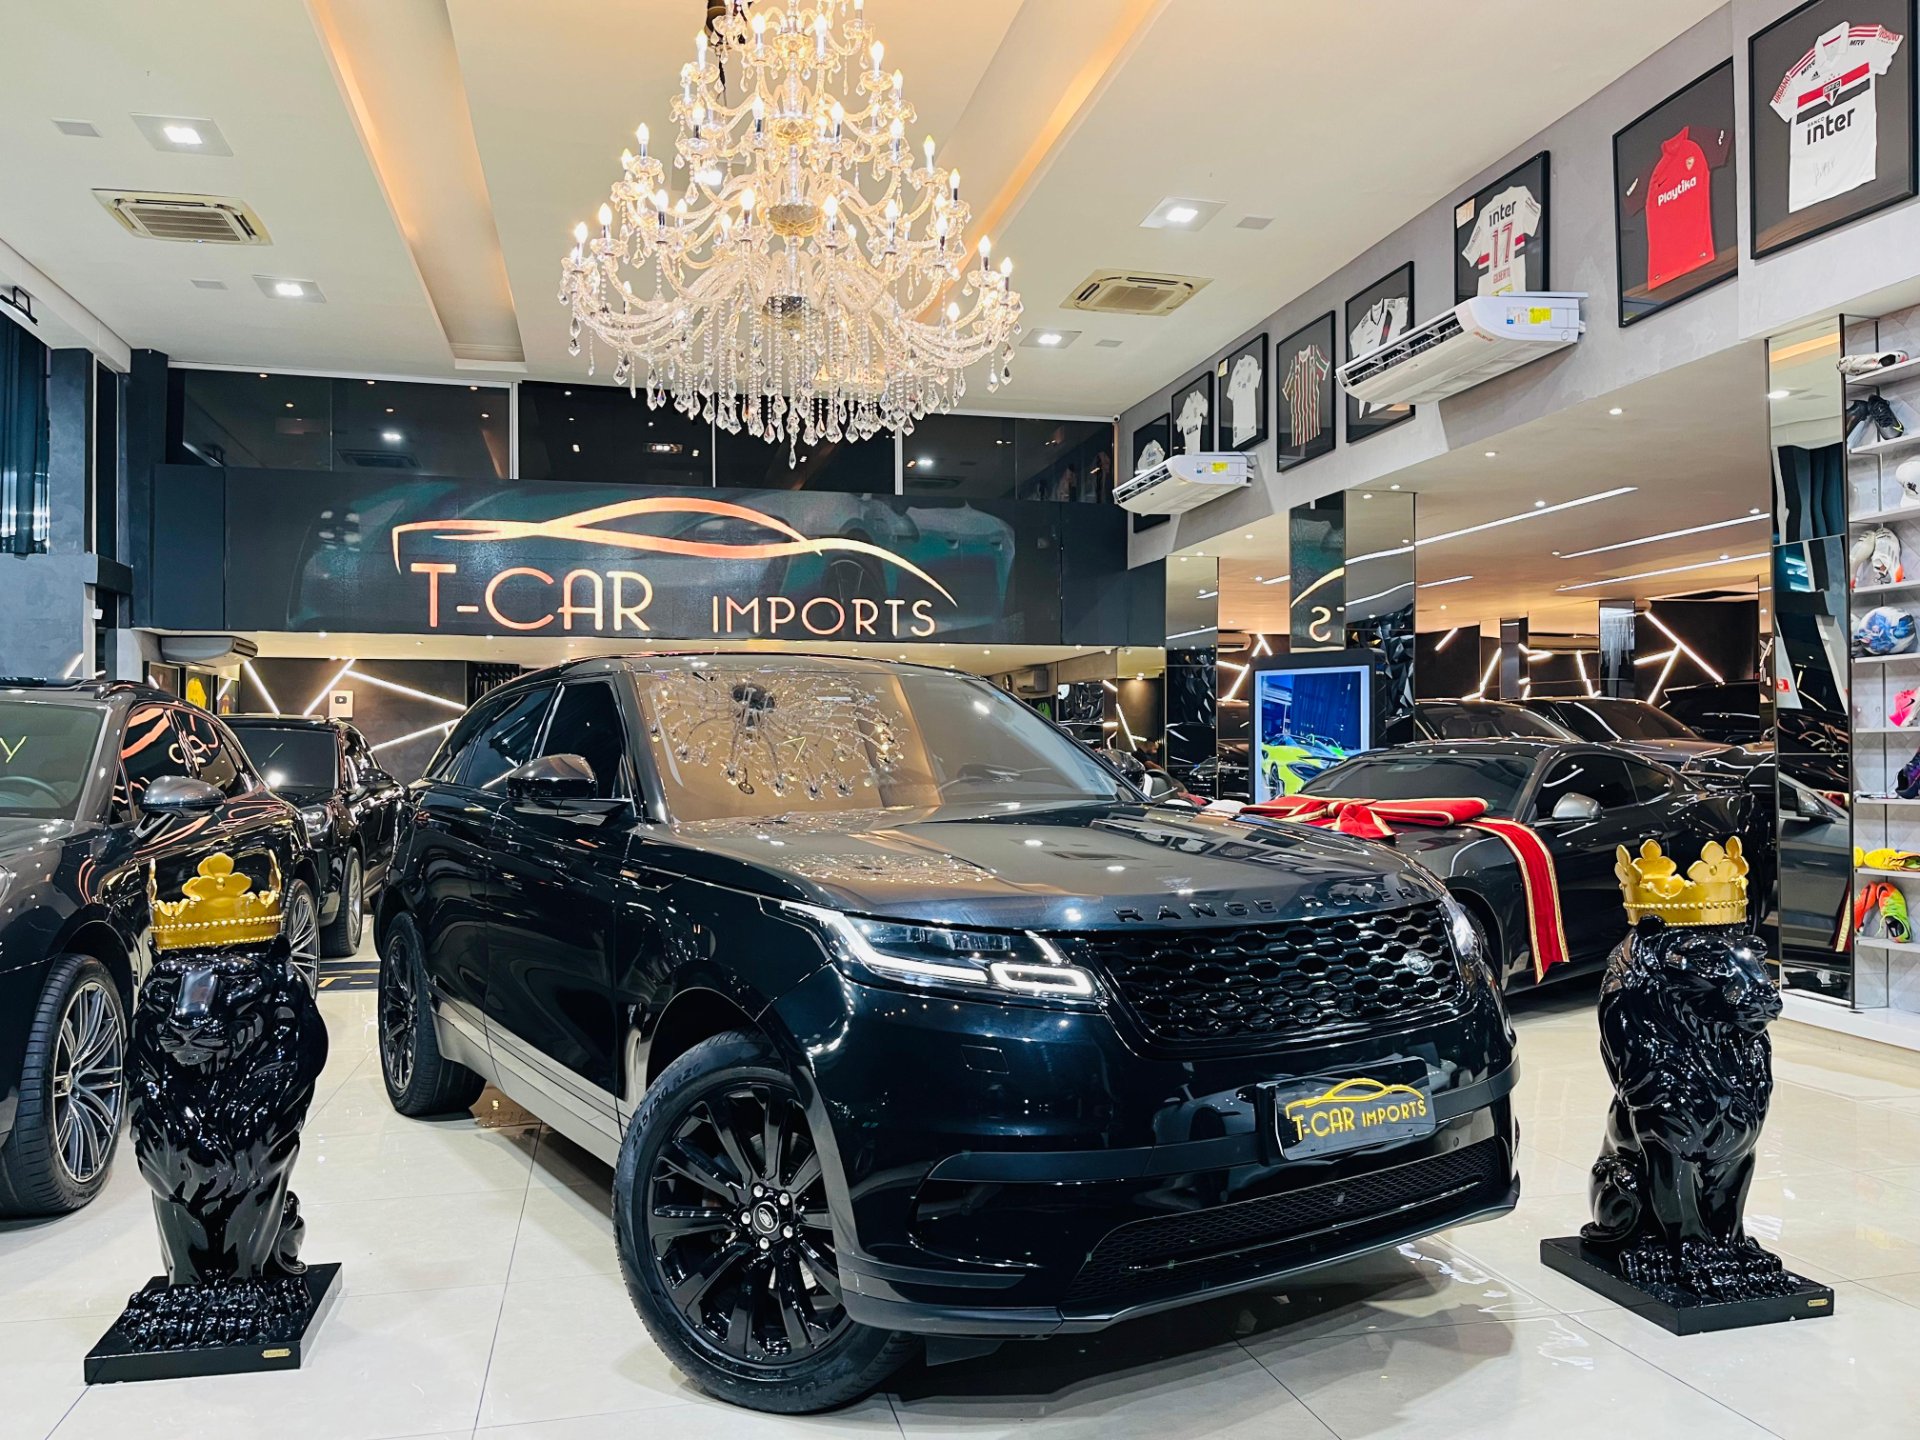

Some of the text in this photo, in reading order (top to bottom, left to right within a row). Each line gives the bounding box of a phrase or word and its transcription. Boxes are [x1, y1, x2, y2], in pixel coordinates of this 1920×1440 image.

[1773, 75, 1791, 104] URBANO
[1807, 108, 1856, 146] inter
[1657, 176, 1697, 207] Playtika
[1489, 201, 1517, 227] inter
[1492, 221, 1513, 268] 17
[410, 563, 937, 637] T-CAR IMPORTS
[1113, 899, 1279, 922] RANGE
[1291, 1100, 1427, 1141] T-CAR IMPORTS
